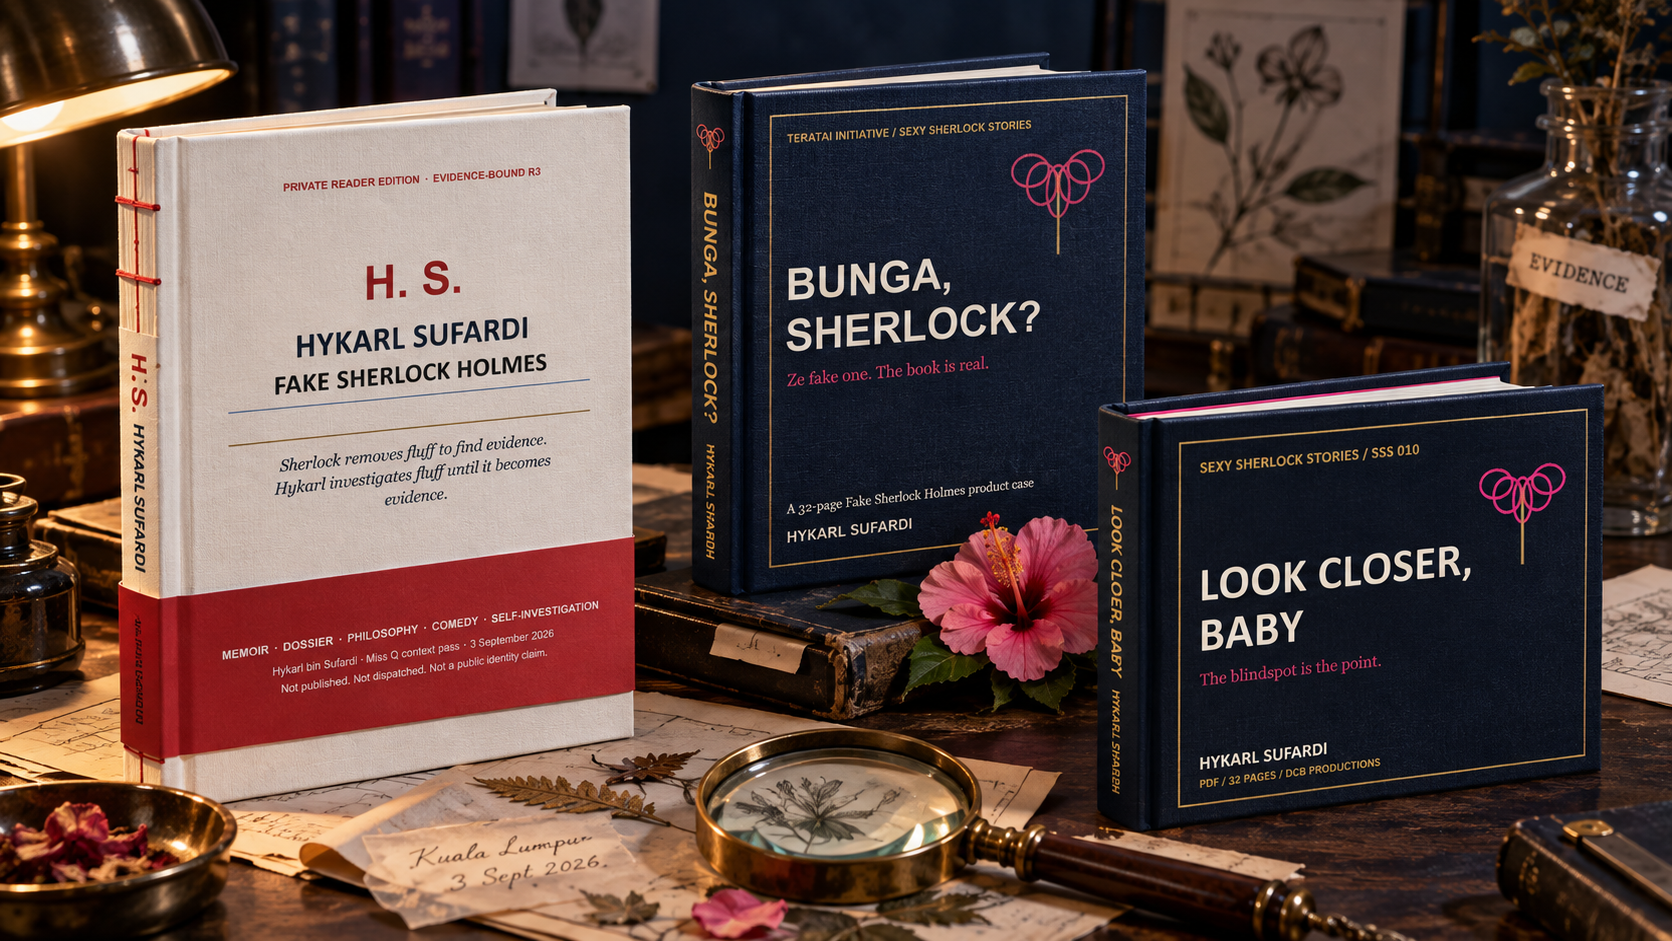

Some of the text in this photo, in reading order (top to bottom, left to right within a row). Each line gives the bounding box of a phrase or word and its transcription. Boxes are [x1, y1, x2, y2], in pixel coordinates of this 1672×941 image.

[787, 120, 1031, 143] TERATAI INITIATIVE / SEXY SHERLOCK STORIES
[284, 181, 328, 192] PRIVATE
[331, 178, 375, 189] READER
[379, 175, 419, 186] EDITION
[433, 168, 525, 182] EVIDENCE-BOUND
[528, 167, 541, 176] R3
[367, 261, 460, 300] H. S.
[788, 258, 950, 300] BUNGA,
[1527, 253, 1629, 296] EVIDENCE
[701, 192, 717, 423] BUNGA, SHERLOCK?
[787, 300, 1040, 351] SHERLOCK?
[297, 317, 527, 358] HYKARL SUFARDI
[275, 354, 546, 395] FAKE SHERLOCK HOLMES
[787, 356, 988, 387] Ze fake one. The book is real.
[132, 387, 147, 412] S.
[279, 435, 546, 472] Sherlock removes fluff to find evidence.
[1200, 444, 1419, 473] SEXY SHERLOCK STORIES / SSS 010
[275, 457, 551, 497] Hykarl investigates fluff until it becomes
[134, 424, 146, 573] HYKARL SUFARDI
[385, 490, 447, 506] evidence.
[787, 480, 1034, 515] A 32-page Fake Sherlock Holmes product case
[787, 518, 912, 543] HYKARL SUFARDI
[1110, 505, 1123, 678] LOOK CLOER, BABY
[1202, 546, 1471, 601] LOOK CLOSER,
[222, 645, 269, 660] MEMOIR
[283, 636, 333, 651] DOSSIER
[348, 625, 418, 642] PHILOSOPHY
[432, 616, 478, 631] COMEDY
[492, 601, 598, 623] SELF-INVESTIGATION
[1202, 610, 1303, 651] BABY
[273, 663, 303, 678] Hykarl
[306, 662, 321, 671] bin
[366, 653, 387, 663] Miss
[391, 650, 398, 659] Q
[402, 646, 435, 658] context
[439, 644, 460, 654] pass
[470, 640, 476, 648] 3
[479, 634, 529, 647] September
[532, 629, 554, 640] 2026
[282, 684, 298, 693] Not
[301, 676, 350, 693] published.
[354, 674, 370, 683] Not
[373, 665, 426, 681] dispatched.
[430, 662, 445, 672] Not
[457, 657, 484, 670] public
[487, 653, 519, 664] identity
[521, 650, 547, 659] claim.
[1200, 656, 1381, 686] The blindspot is the point.
[1200, 742, 1327, 770] HYKARL SUFARDI
[1200, 758, 1381, 788] PDF / 32 PAGES / DCB PRODUCTIONS
[409, 835, 593, 870] Kuala Lumpur
[447, 874, 466, 893] 3
